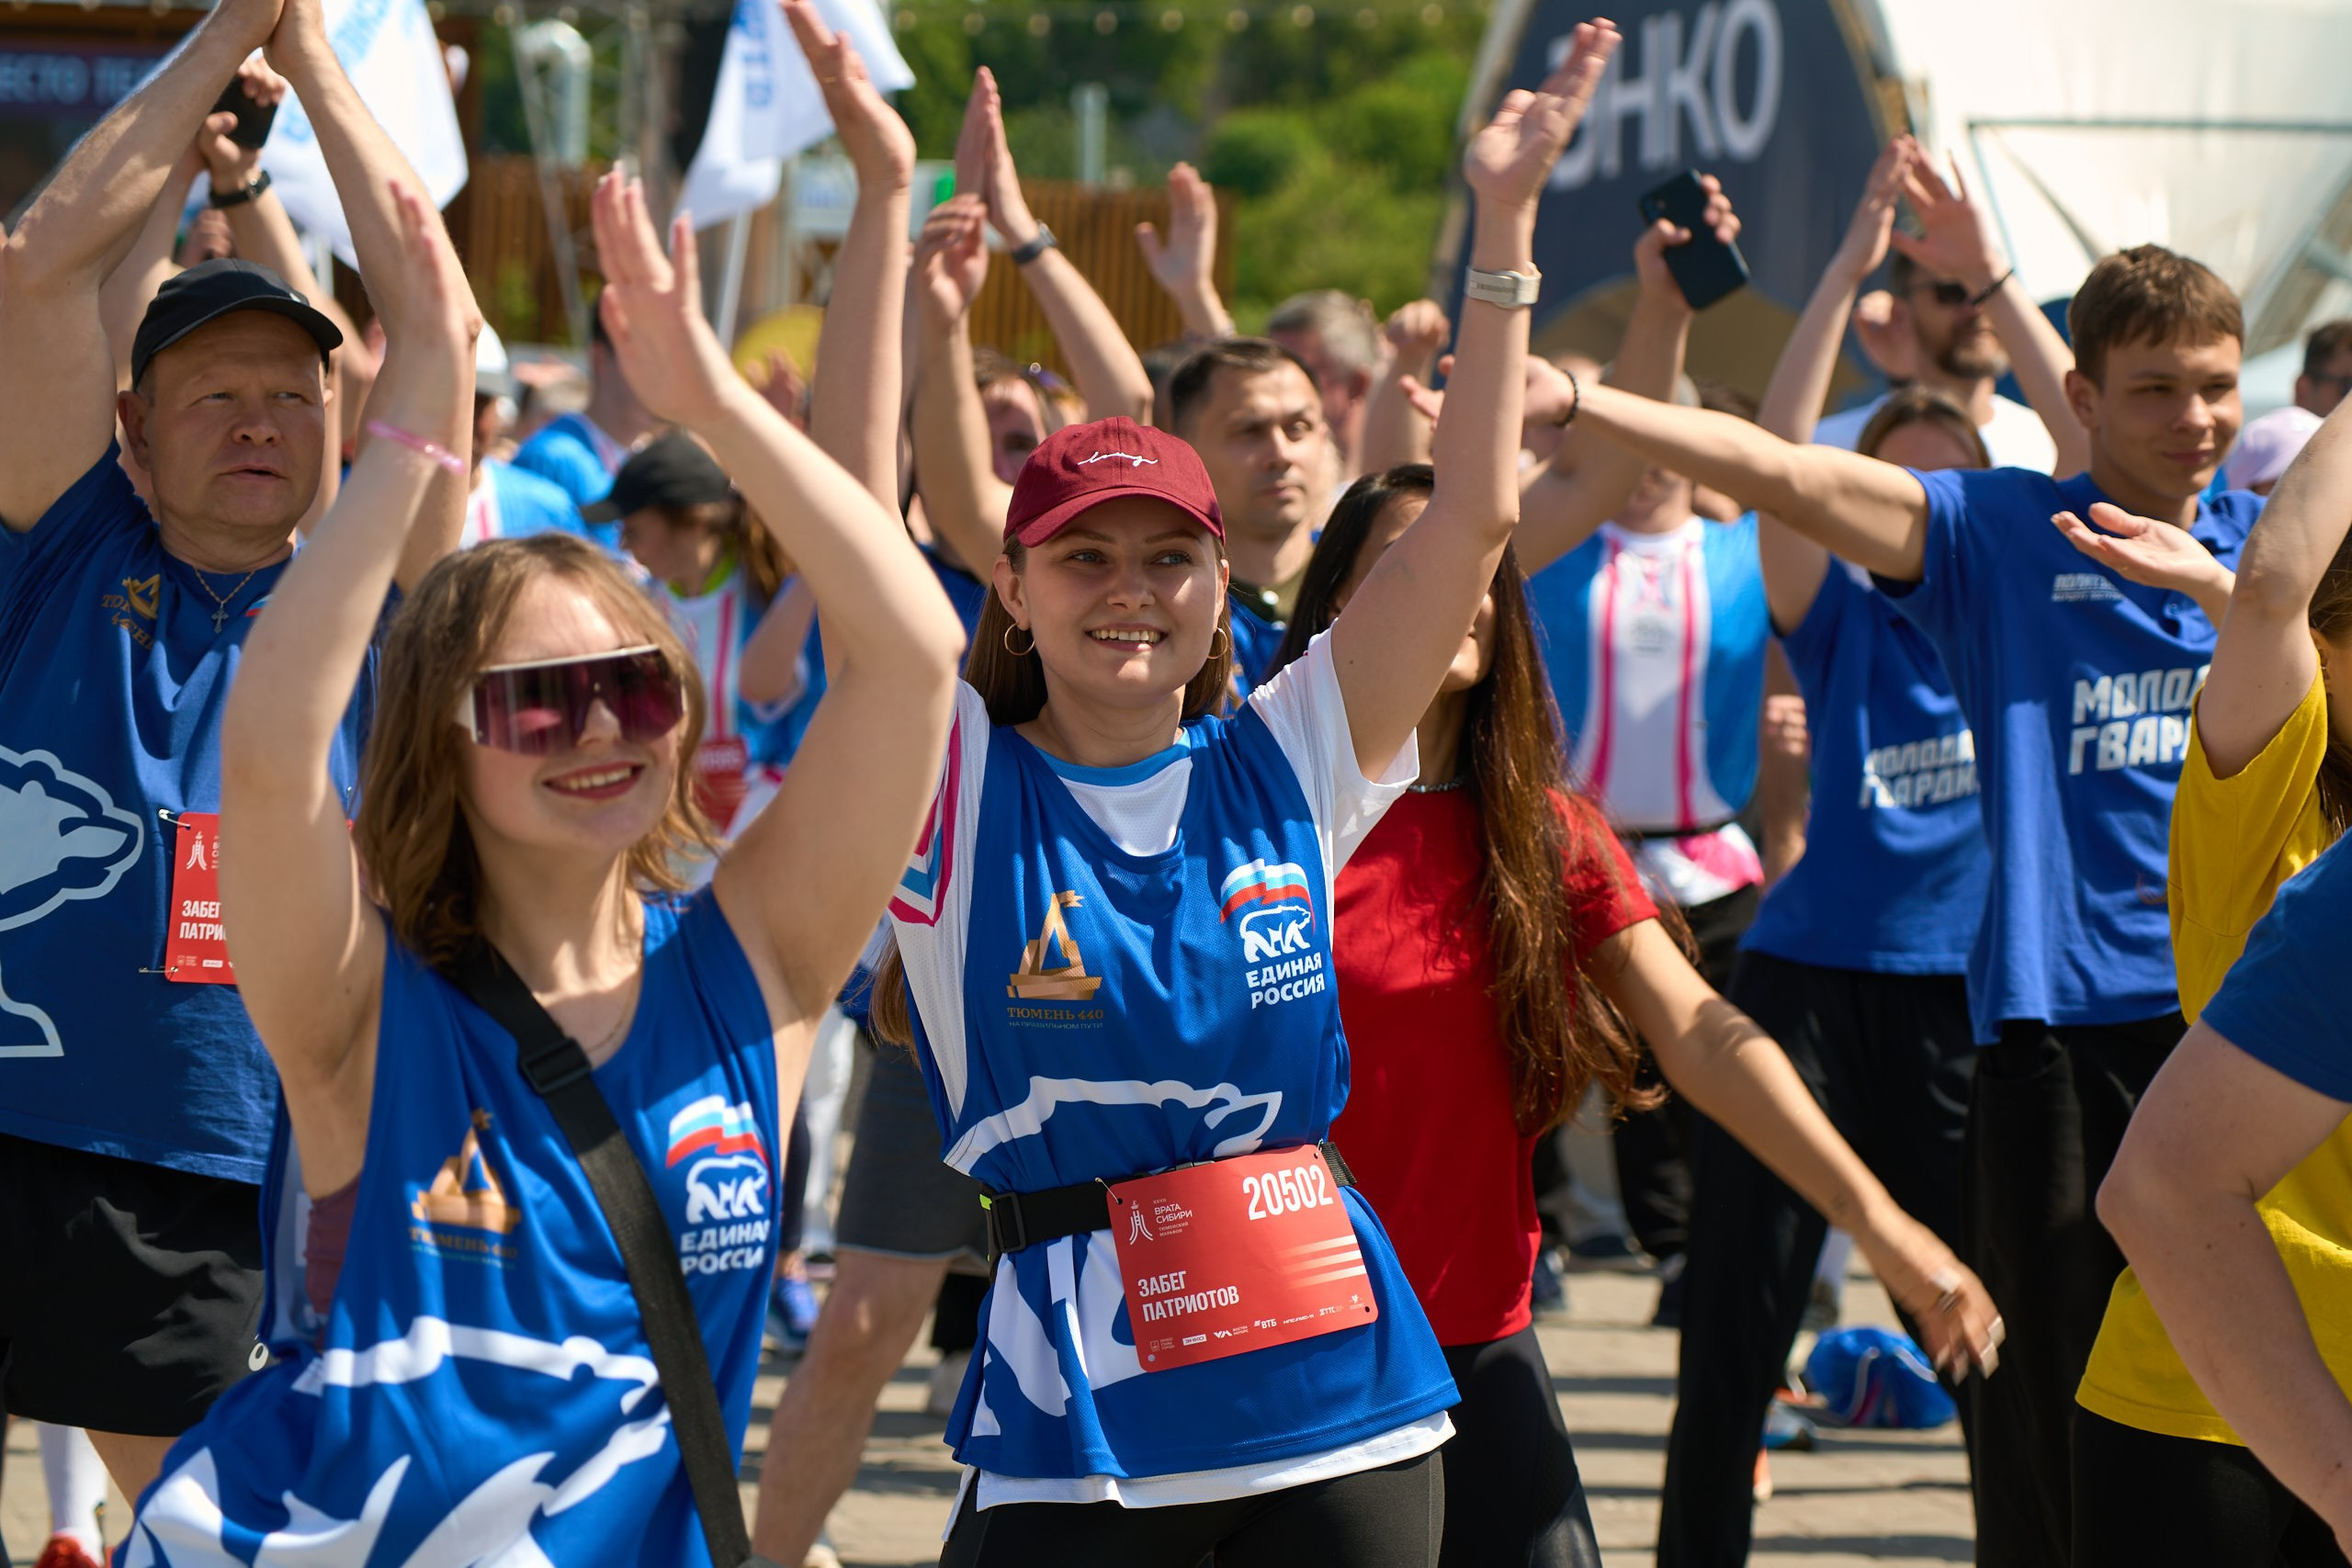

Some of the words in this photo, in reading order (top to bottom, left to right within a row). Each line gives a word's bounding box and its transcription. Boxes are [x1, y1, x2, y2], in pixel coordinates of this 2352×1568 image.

[2069, 710, 2193, 775] ГВАР
[179, 921, 227, 941] ПАТРИ
[1245, 952, 1322, 988] ЕДИНАЯ
[1251, 973, 1325, 1010] РОССИЯ
[1007, 1007, 1075, 1020] ТЮМЕНЬ
[1078, 1010, 1103, 1020] 440
[1243, 1164, 1333, 1221] 20502
[1154, 1203, 1182, 1215] ВРАТА
[1156, 1209, 1193, 1224] СИБИРИ
[1137, 1270, 1187, 1298] ЗАБЕГ
[1142, 1285, 1240, 1323] ПАТРИОТОВ
[1261, 1318, 1277, 1329] ВТБ
